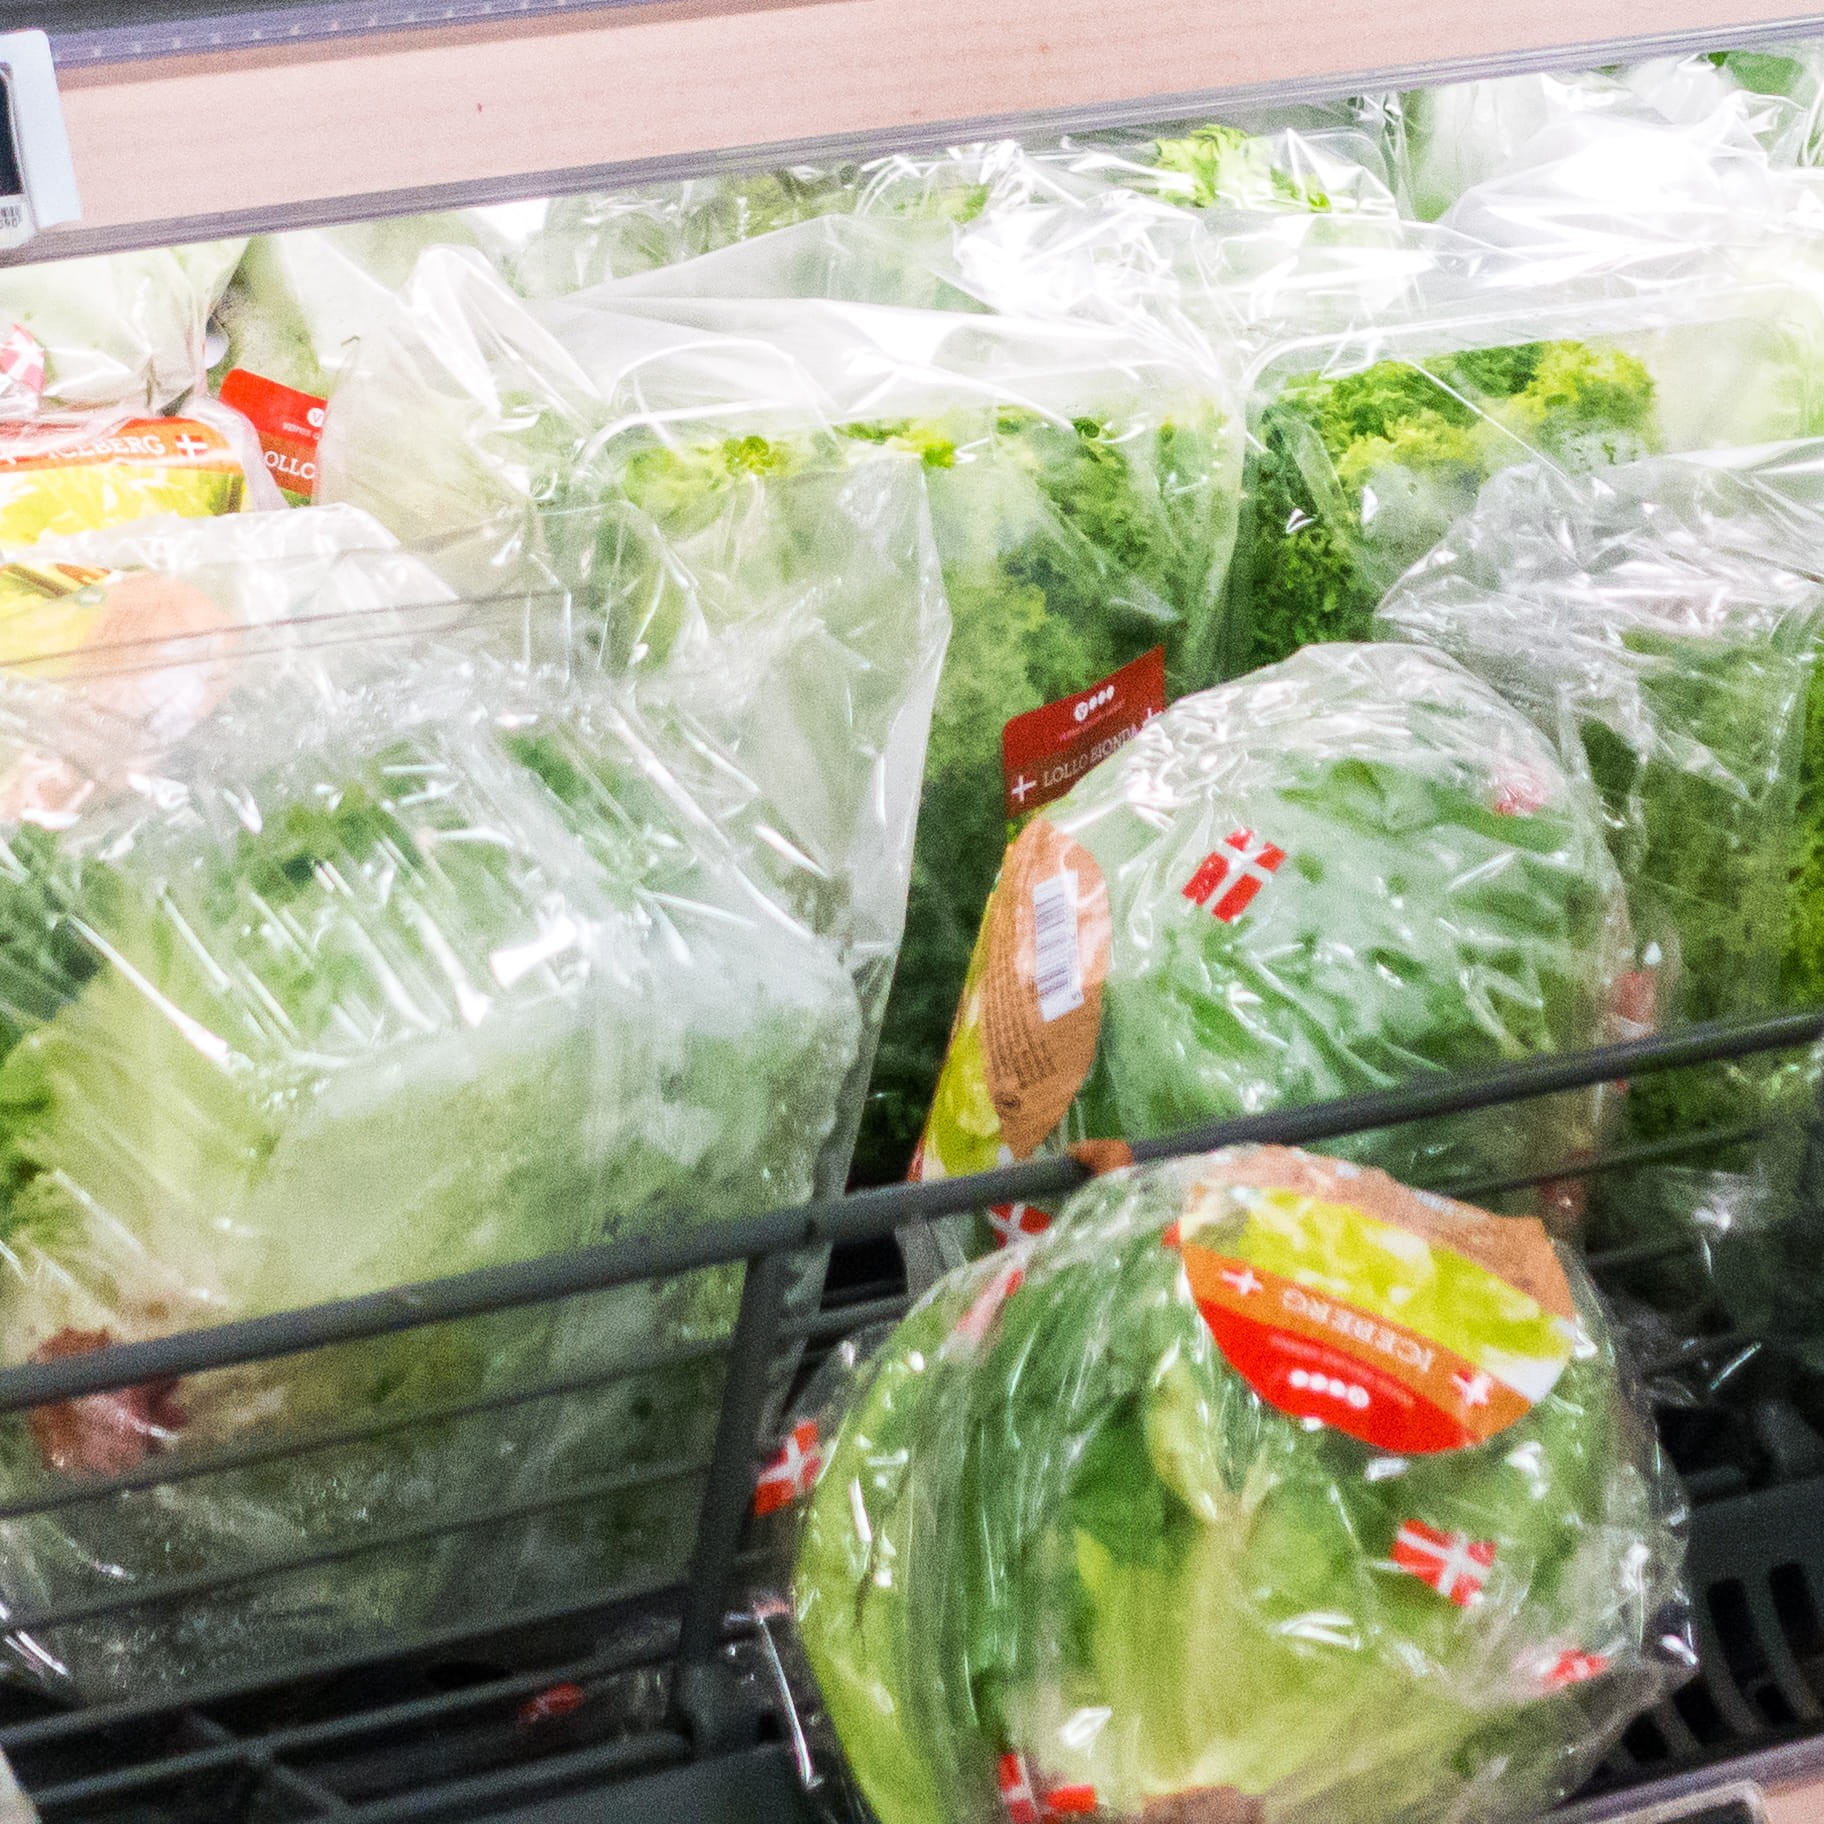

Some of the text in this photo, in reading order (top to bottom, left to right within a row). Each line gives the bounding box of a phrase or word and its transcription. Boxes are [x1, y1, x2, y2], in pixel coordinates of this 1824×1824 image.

[263, 450, 317, 480] OLLO
[1043, 754, 1088, 787] LOLLO
[1281, 1288, 1435, 1374] ICEBERG
